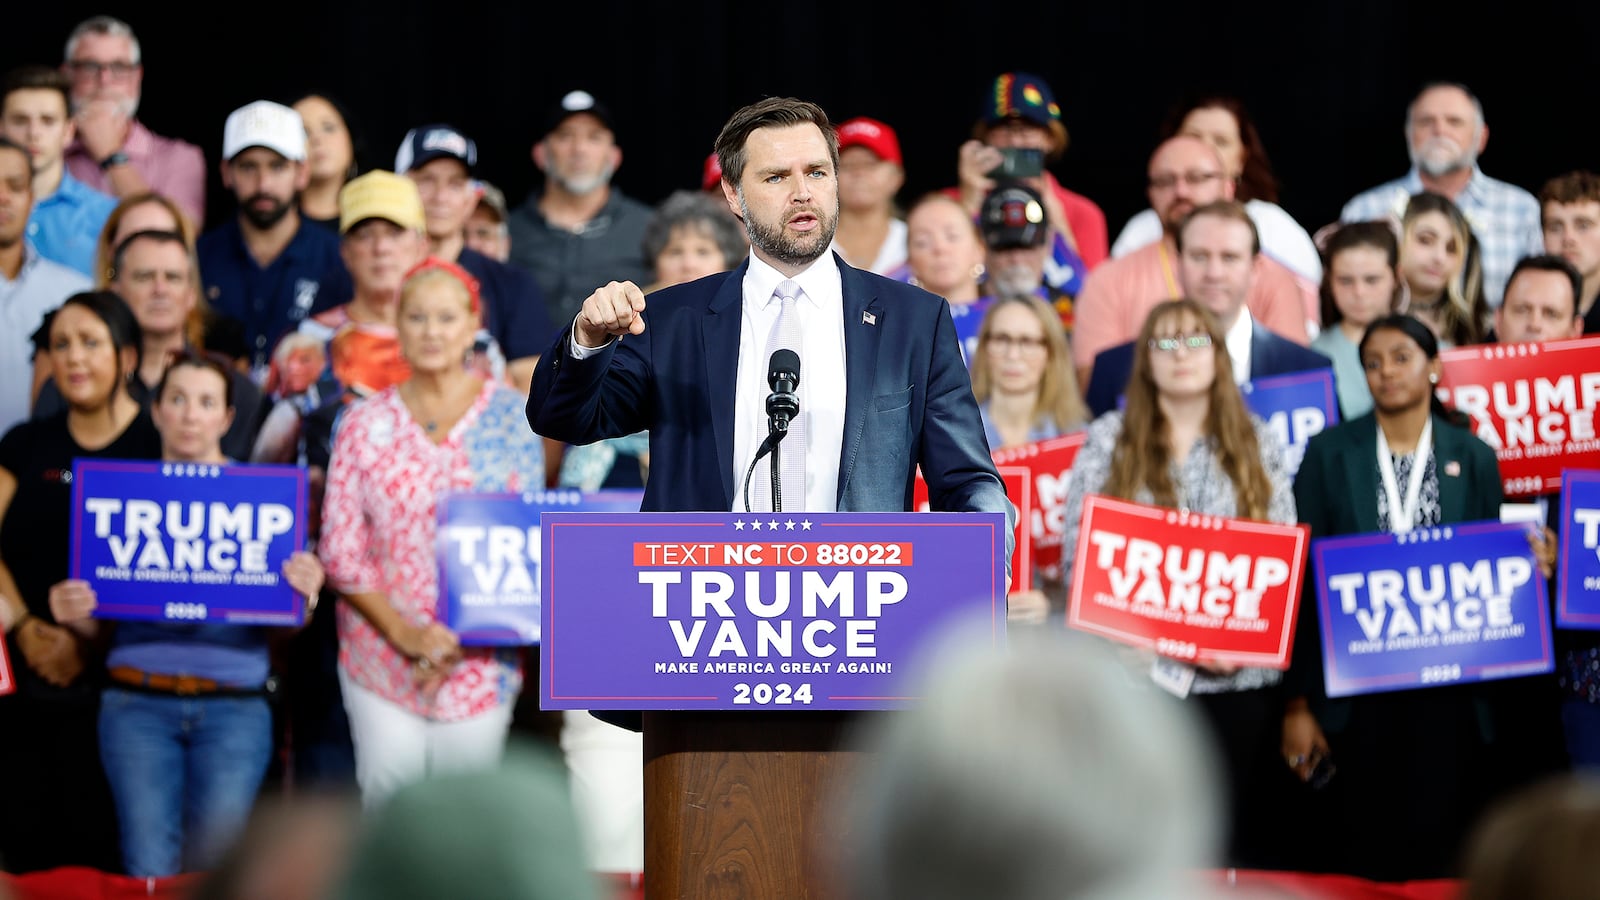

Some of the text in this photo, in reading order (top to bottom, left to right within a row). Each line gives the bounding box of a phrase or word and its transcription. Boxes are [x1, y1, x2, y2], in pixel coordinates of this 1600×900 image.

[1434, 372, 1600, 422] RUMP
[1476, 409, 1596, 450] ANCE
[85, 498, 294, 543] TRUMP
[107, 534, 270, 574] VANCE
[645, 543, 903, 566] TEXT NC TO 88022
[1090, 530, 1290, 593] TRUMP
[638, 570, 909, 618] TRUMP
[1108, 566, 1264, 620] VANCE
[1328, 556, 1532, 614] TRUMP
[668, 619, 878, 658] VANCE
[1355, 594, 1514, 642] VANCE
[654, 662, 893, 674] MAKE AMERICA GREAT AGAIN!
[732, 682, 814, 705] 2024
